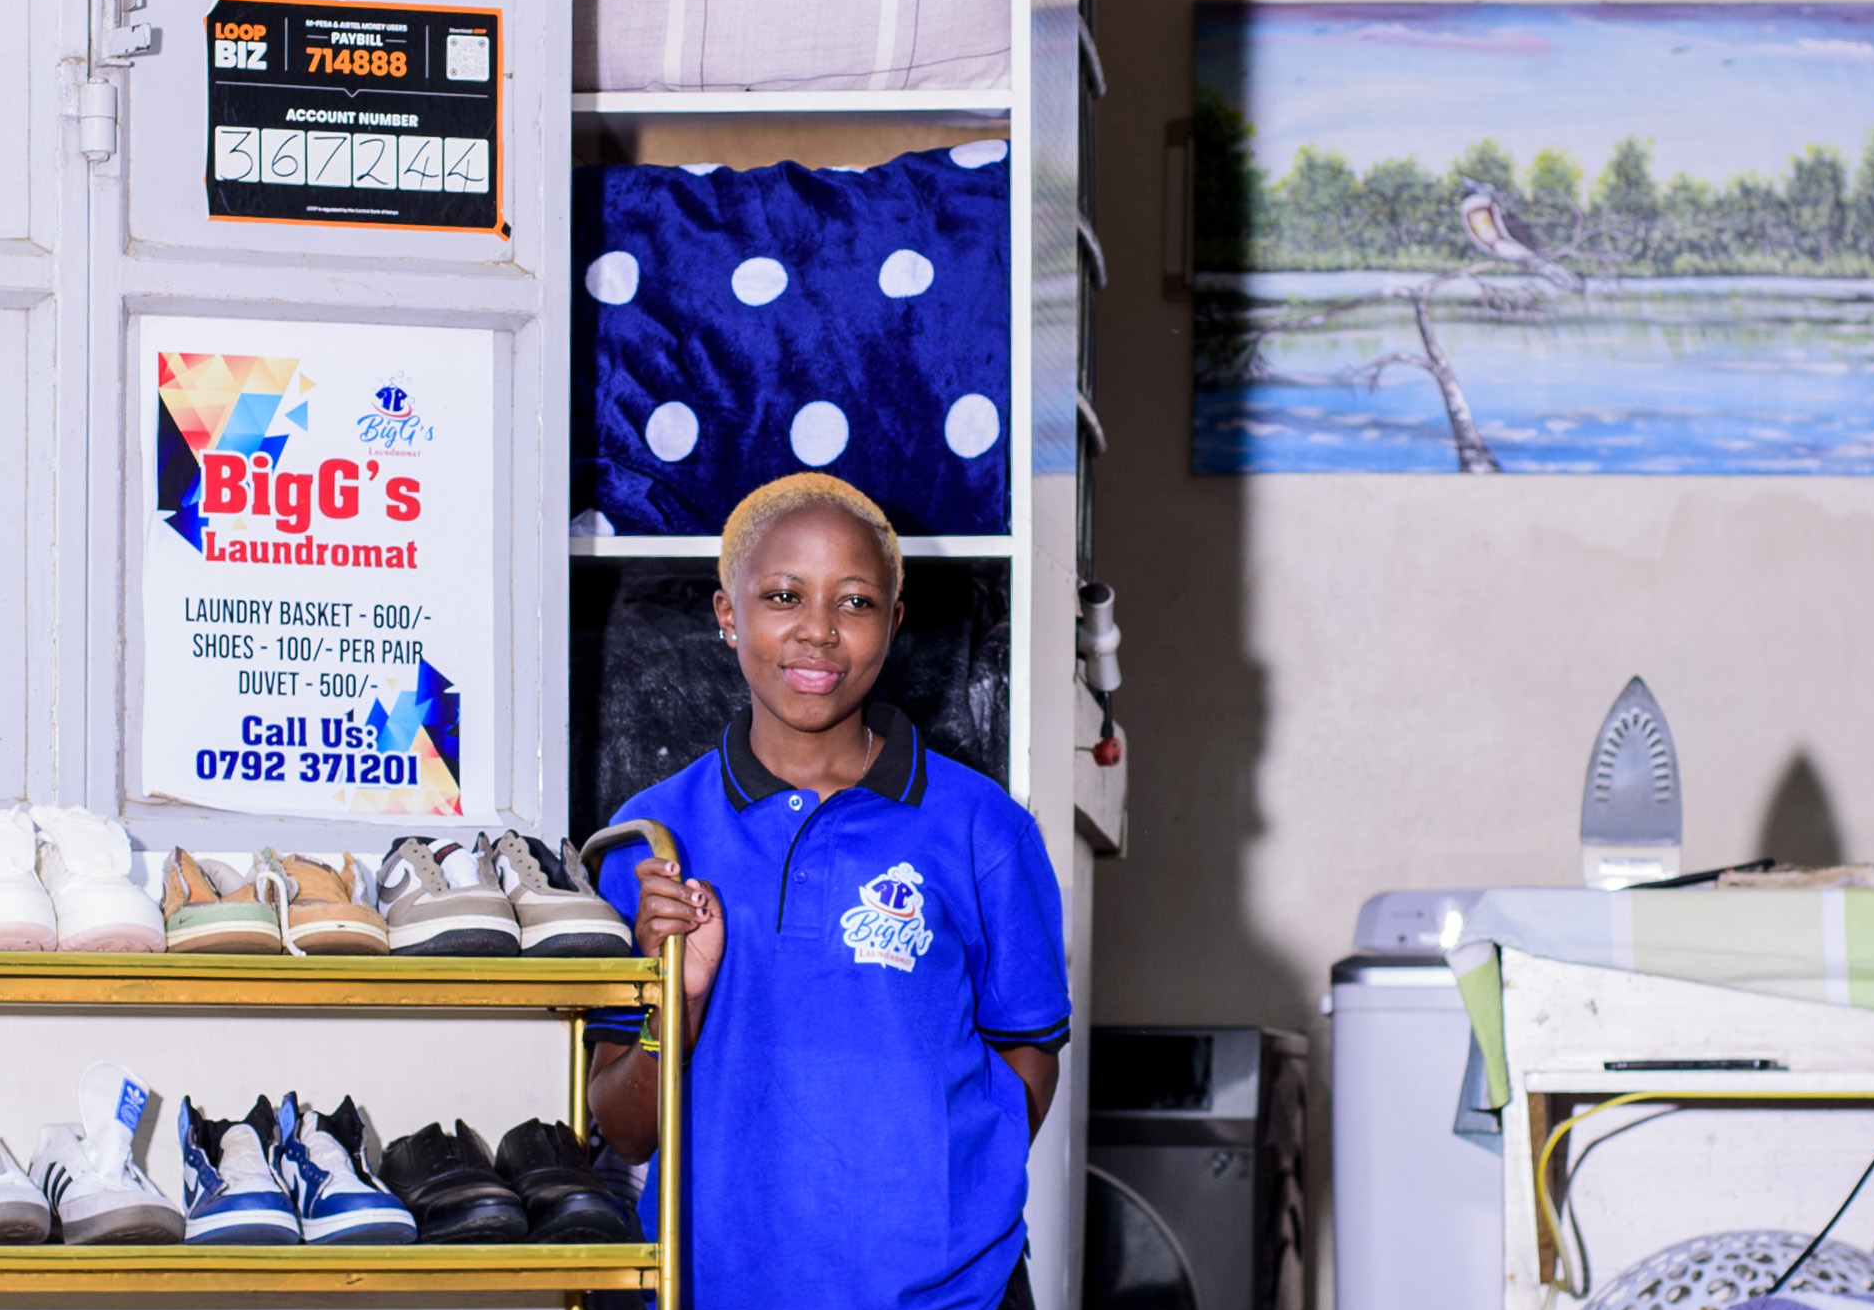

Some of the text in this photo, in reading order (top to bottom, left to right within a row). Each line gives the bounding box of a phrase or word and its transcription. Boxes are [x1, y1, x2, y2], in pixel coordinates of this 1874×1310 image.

[215, 23, 266, 41] LOOP
[331, 32, 384, 47] PAYBILL
[215, 41, 267, 70] BIZ
[306, 47, 407, 77] 714888
[286, 109, 418, 128] ACCOUNT NUMBER
[202, 455, 422, 534] BigG's
[205, 532, 418, 569] Laundromat
[185, 598, 273, 624] LAUNDRY
[280, 602, 353, 628] BASKET
[373, 605, 431, 630] 600/-
[192, 635, 254, 659] SHOES
[276, 637, 333, 662] 100/-
[340, 640, 375, 664] PER
[382, 641, 424, 665] PAIR
[239, 671, 299, 696] DUVET
[320, 673, 378, 699] 500/-
[242, 715, 374, 749] Call Us:
[196, 750, 418, 786] 0792 371201
